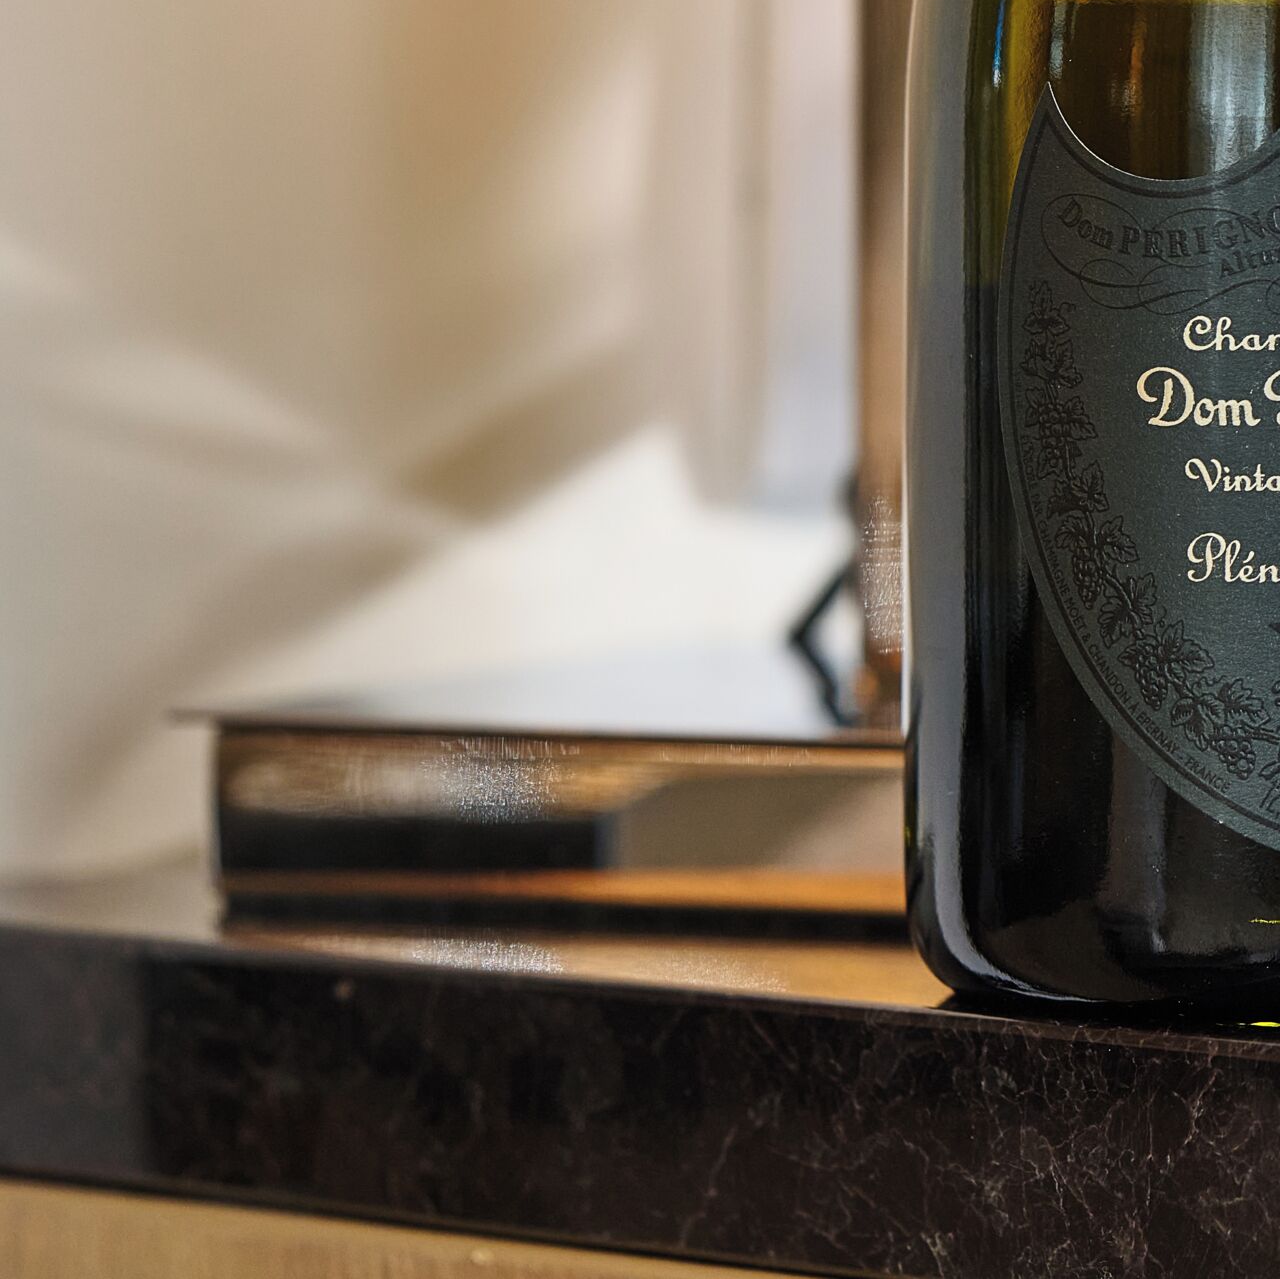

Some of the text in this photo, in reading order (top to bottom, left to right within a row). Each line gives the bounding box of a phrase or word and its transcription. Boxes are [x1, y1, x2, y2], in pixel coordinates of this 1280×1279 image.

[1057, 196, 1114, 250] Dom
[1136, 366, 1261, 428] Dom
[1088, 644, 1132, 704] CHANDON
[1184, 755, 1230, 793] FRANCE
